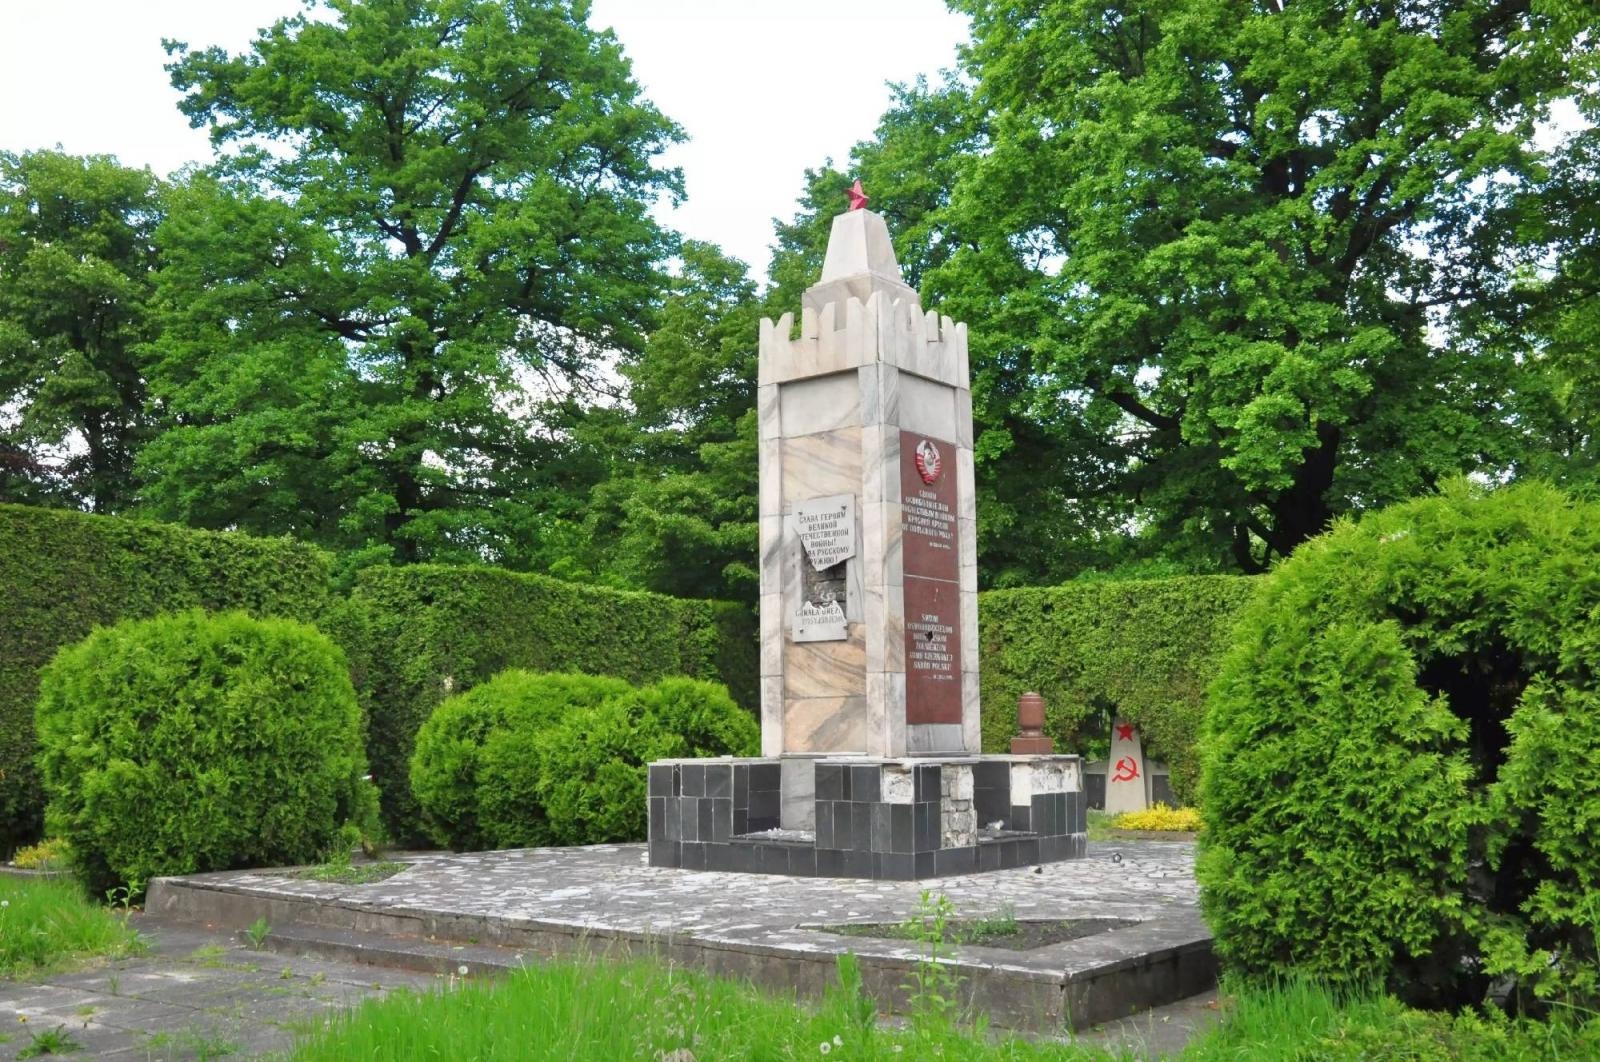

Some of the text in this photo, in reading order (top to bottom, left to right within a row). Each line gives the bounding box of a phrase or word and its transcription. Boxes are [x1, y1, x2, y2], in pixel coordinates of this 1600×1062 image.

[799, 511, 846, 524] СЛАВА ГЕРОЯМ
[808, 520, 837, 531] ВЕЛИКОЙ
[801, 529, 849, 541] ТЕЧЕСТВЕННОЙ
[817, 546, 850, 556] РУССКОМУ
